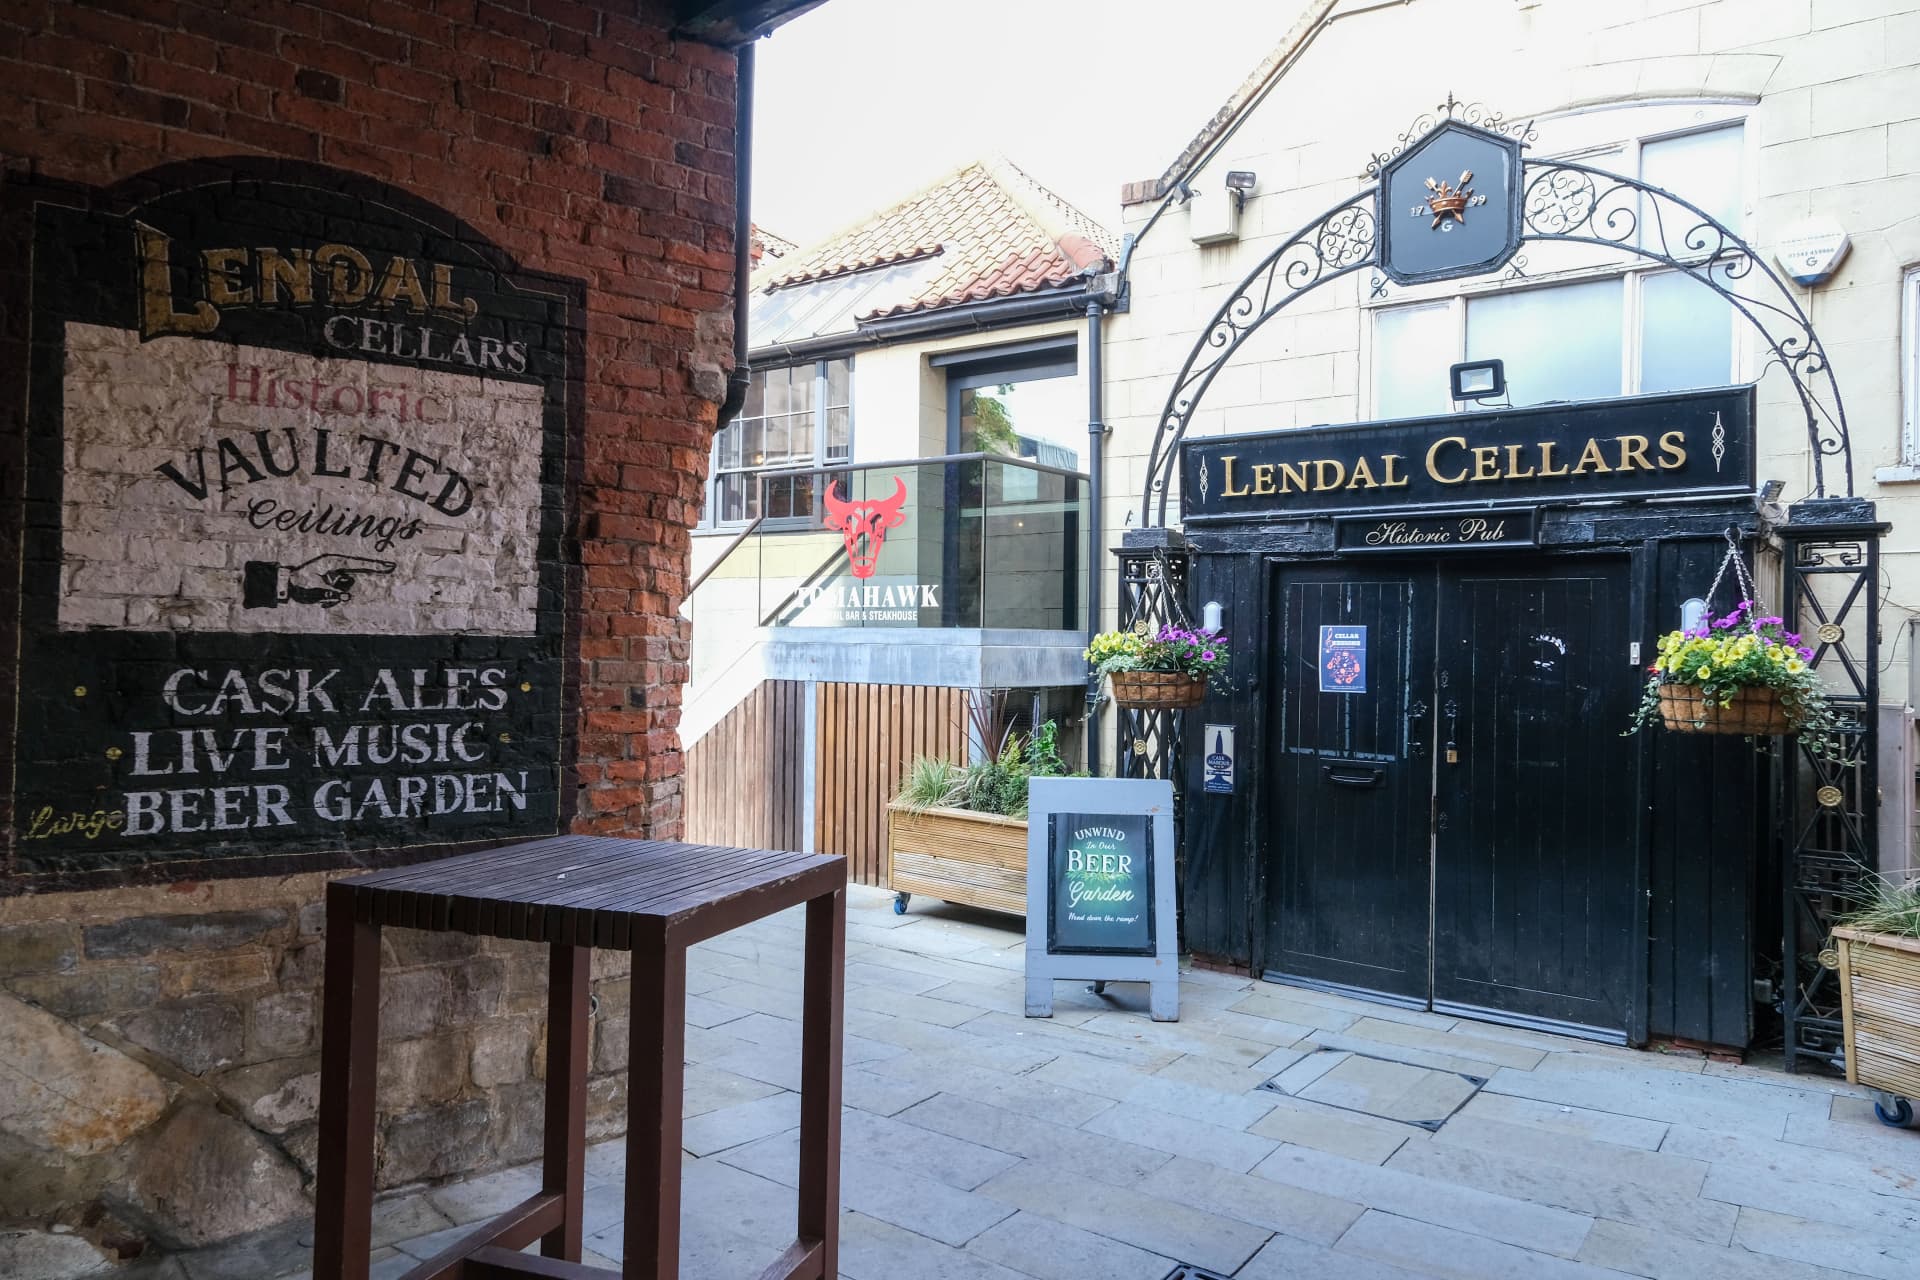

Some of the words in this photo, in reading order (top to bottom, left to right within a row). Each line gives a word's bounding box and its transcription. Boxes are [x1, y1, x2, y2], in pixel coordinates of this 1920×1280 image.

[1411, 205, 1424, 217] 17
[1471, 194, 1487, 206] 99
[135, 220, 479, 342] LENDAL
[324, 314, 528, 375] CELLARS
[226, 362, 443, 424] Historic
[155, 426, 475, 518] VAULTED
[1220, 453, 1408, 498] LENDAL
[1424, 431, 1688, 485] CELLARS
[245, 497, 424, 552] Ceilings
[1366, 521, 1452, 546] Historic
[1459, 517, 1504, 543] Pub
[845, 611, 860, 621] BAR
[869, 611, 918, 621] STEAKHOUSE
[162, 667, 342, 716] CASK
[359, 666, 509, 713] ALES
[128, 726, 291, 776] LIVE
[312, 721, 487, 768] MUSIC
[21, 804, 124, 841] Large
[120, 783, 299, 838] BEER
[312, 770, 529, 823] GARDEN
[1067, 849, 1132, 874] BEER
[1074, 827, 1126, 841] UNWIND
[1067, 881, 1135, 908] Garden
